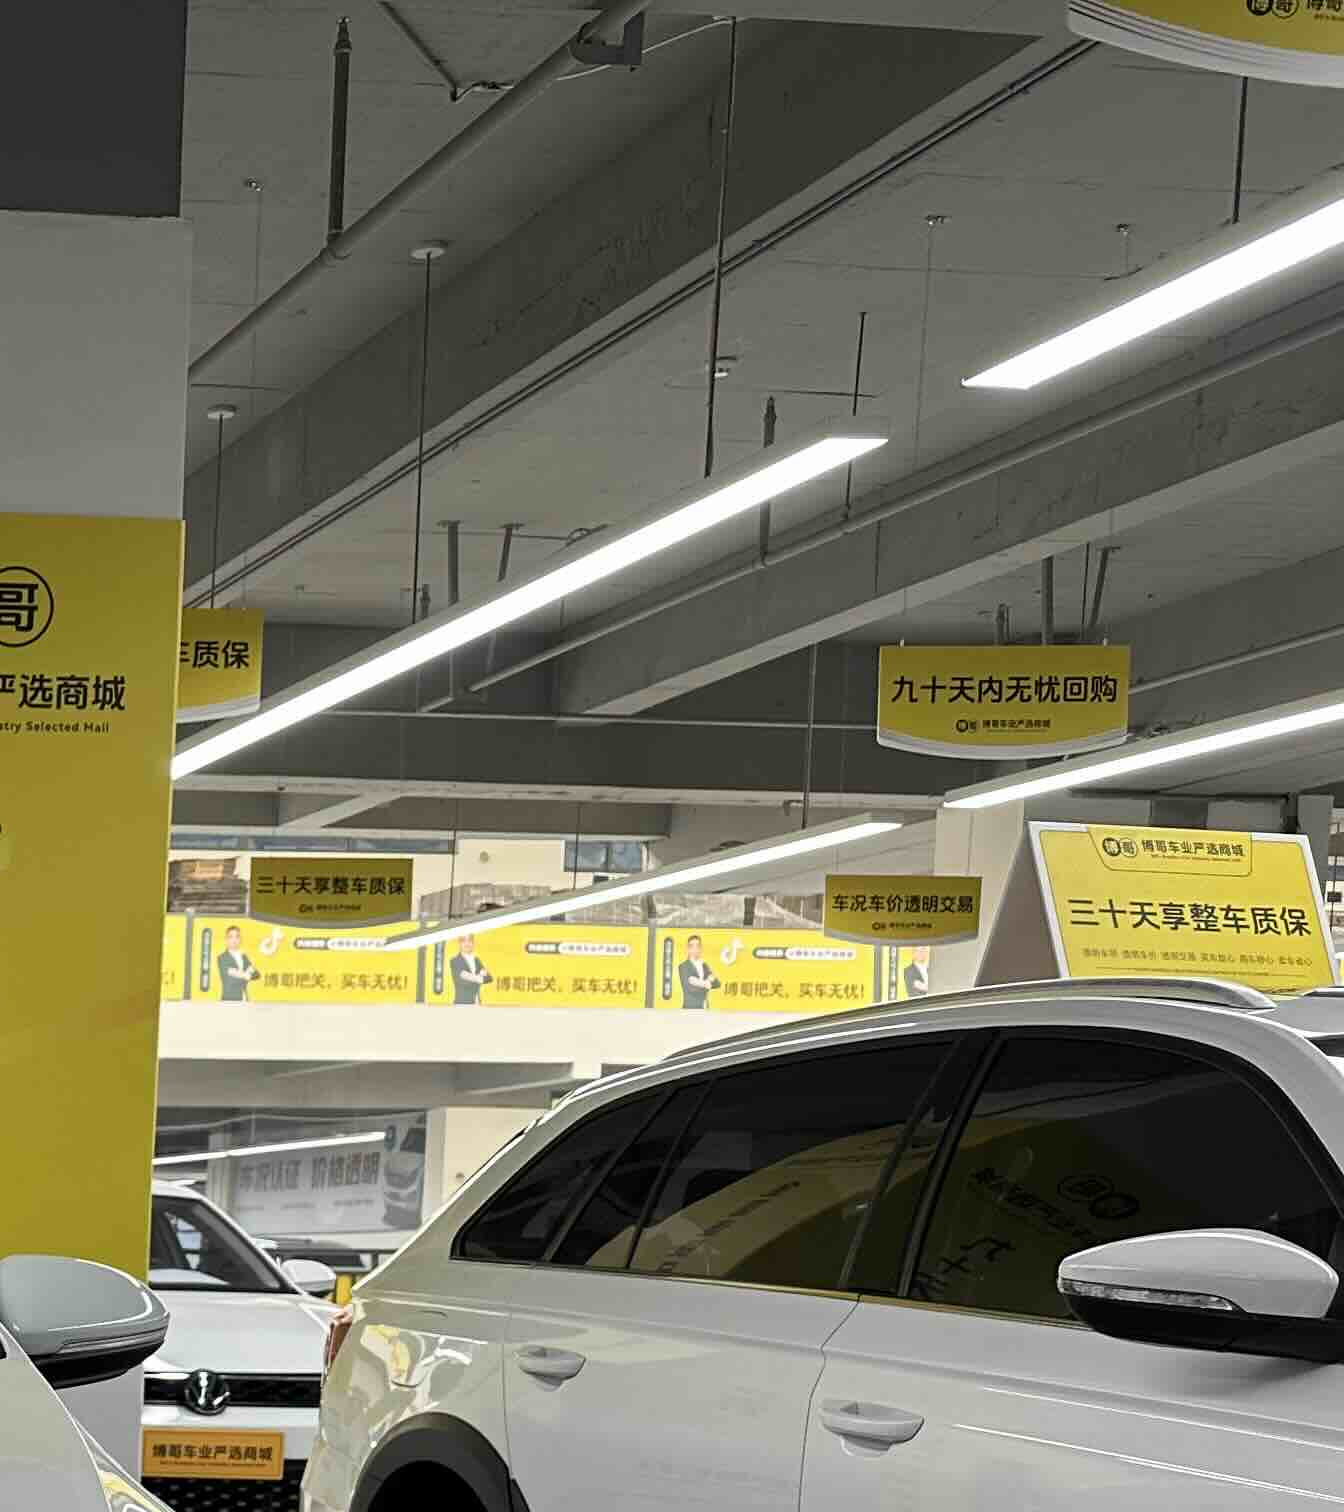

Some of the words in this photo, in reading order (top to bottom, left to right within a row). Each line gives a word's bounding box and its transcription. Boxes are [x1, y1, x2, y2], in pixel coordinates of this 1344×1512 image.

[891, 675, 1118, 704] 九十天内无忧回购
[26, 721, 79, 733] Selected
[83, 722, 109, 733] Mall
[256, 875, 406, 896] 三十天享整车质保
[831, 893, 974, 915] 车况车价透明交易
[1067, 897, 1312, 938] 三十天享整车质保
